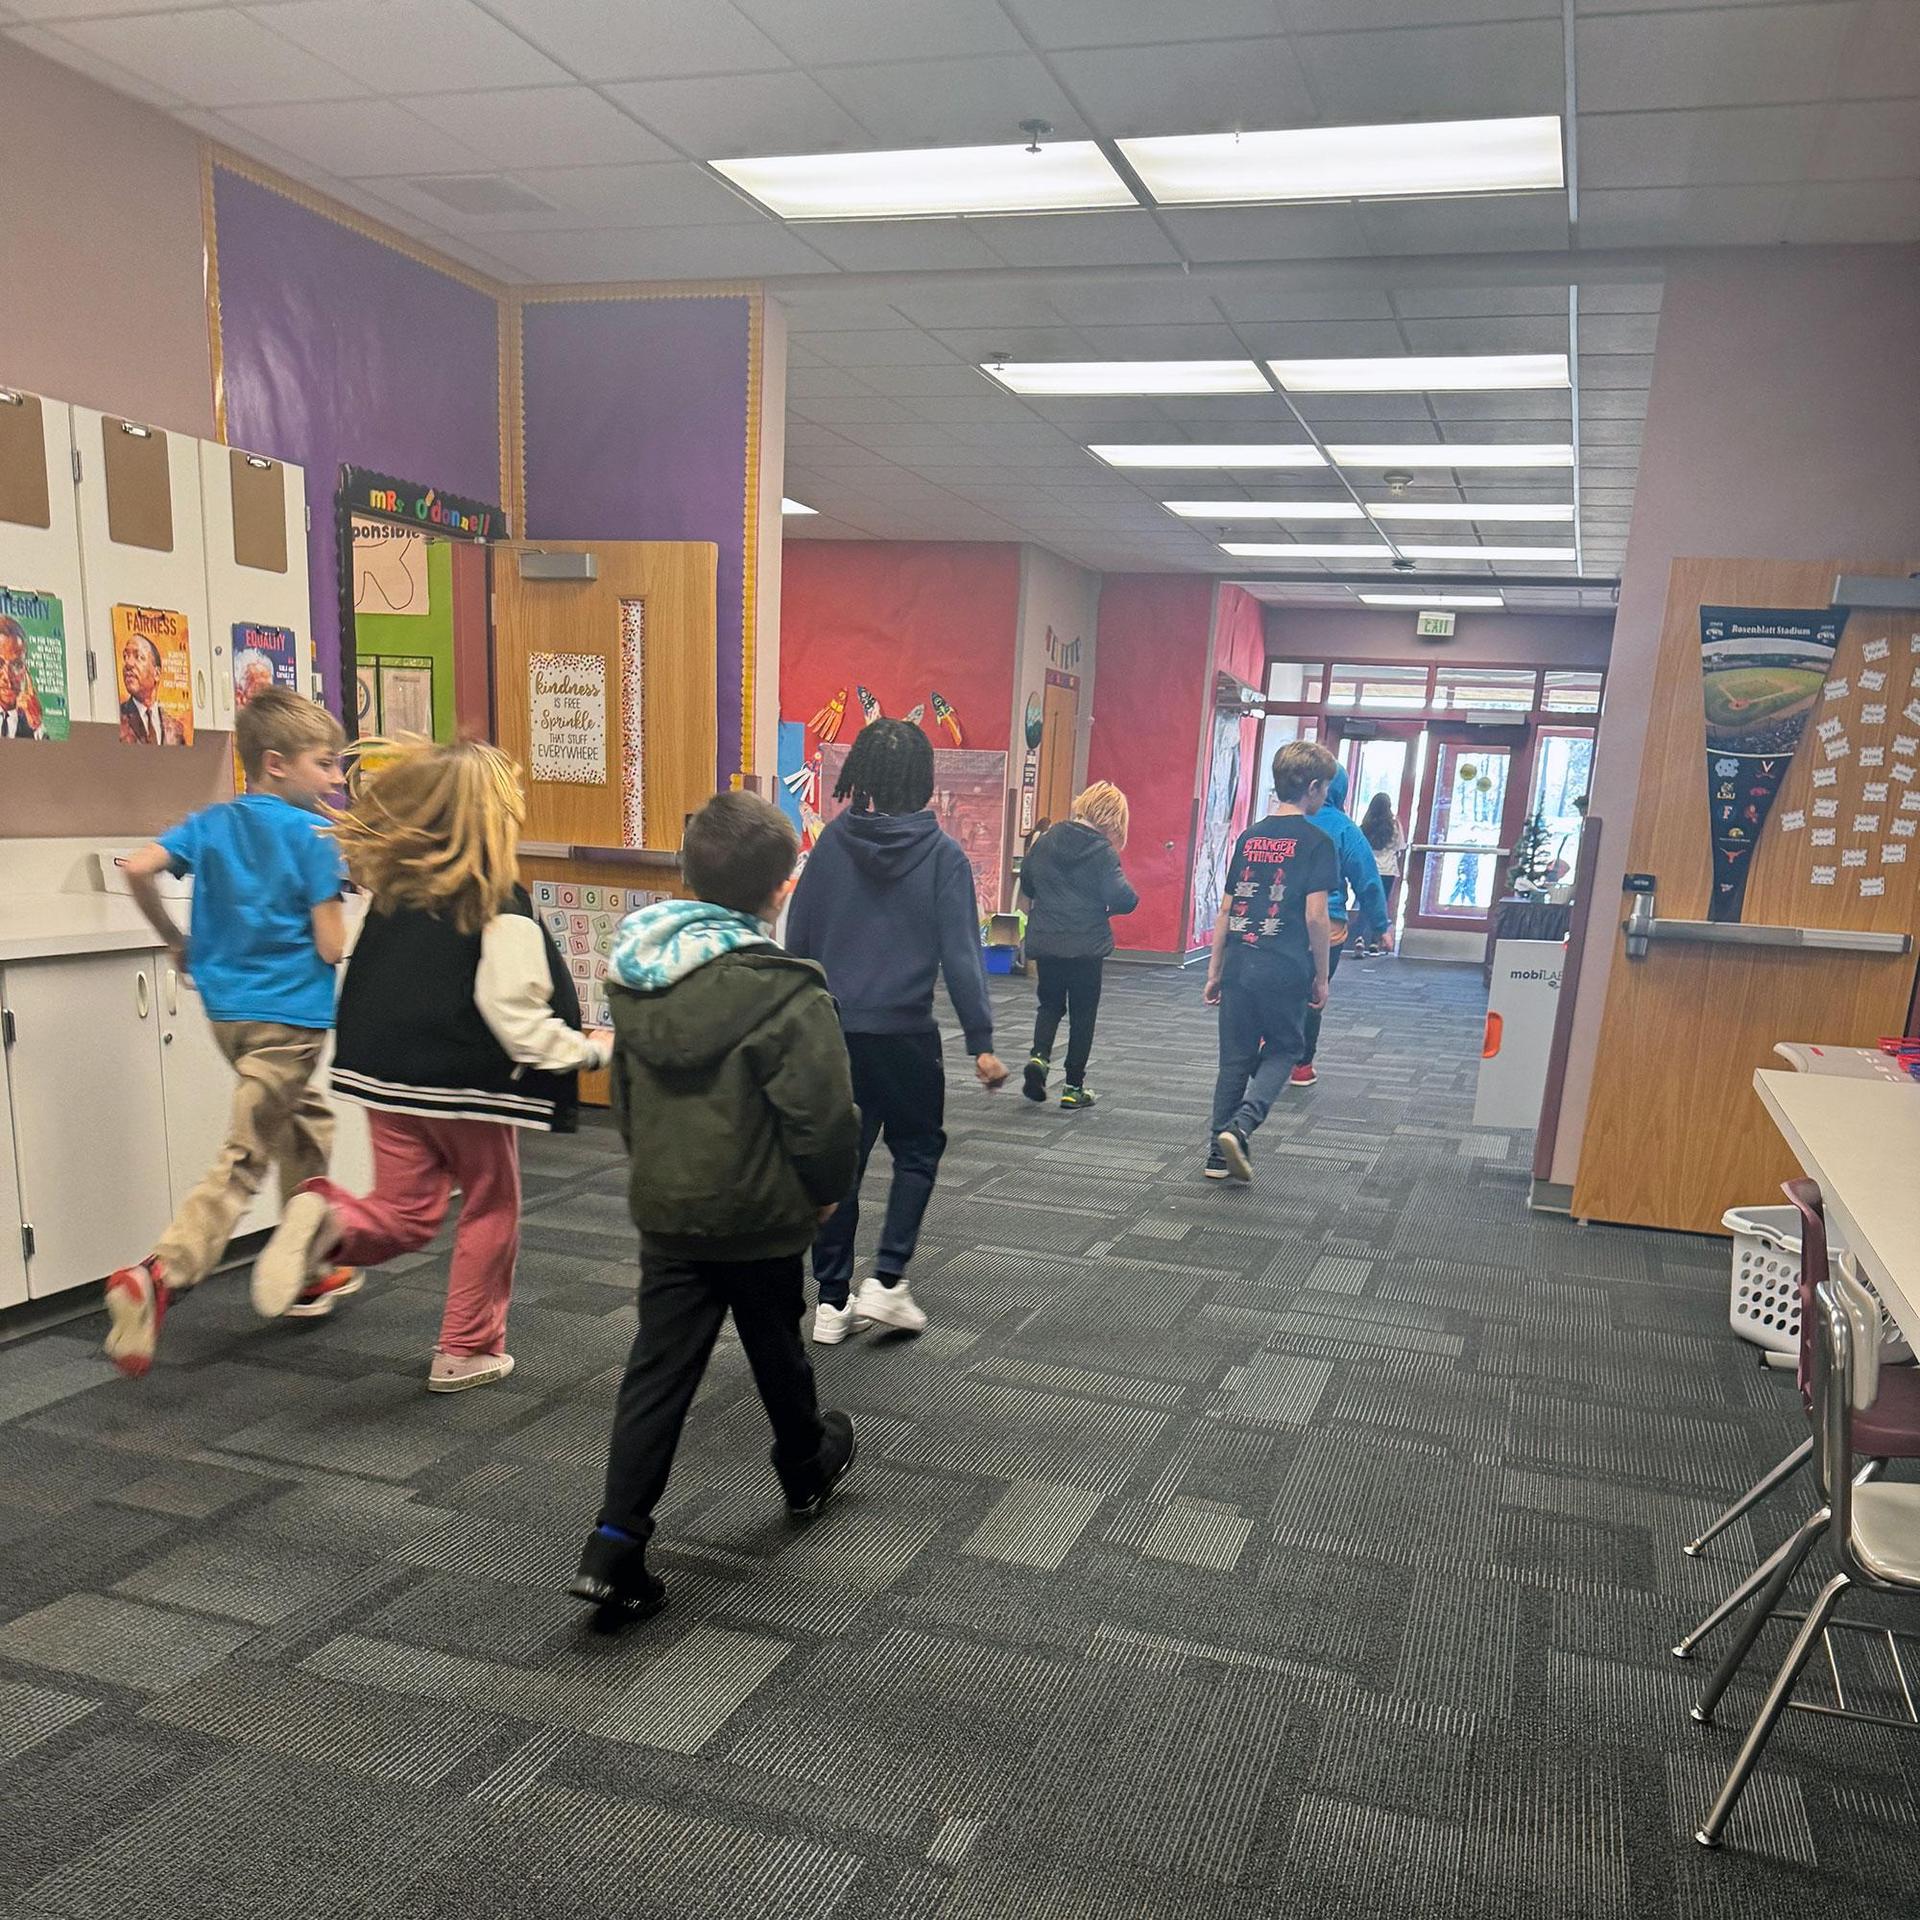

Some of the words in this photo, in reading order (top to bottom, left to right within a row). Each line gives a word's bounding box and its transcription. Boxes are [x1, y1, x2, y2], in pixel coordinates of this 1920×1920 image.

[126, 611, 177, 635] FAIRNESS
[1424, 618, 1448, 633] EXIT
[1731, 624, 1776, 635] Rosenblatt
[1776, 625, 1811, 635] Stadium
[245, 629, 285, 651] EQUALITY
[535, 671, 601, 697] kindness
[554, 698, 561, 708] IS
[564, 698, 581, 709] FREE
[541, 709, 596, 731] Sprinkle
[550, 733, 564, 744] THAT
[568, 734, 588, 745] STUFF
[538, 744, 599, 761] EVERYWHERE
[1243, 837, 1298, 857] STRANGER
[1247, 851, 1285, 863] THINGS
